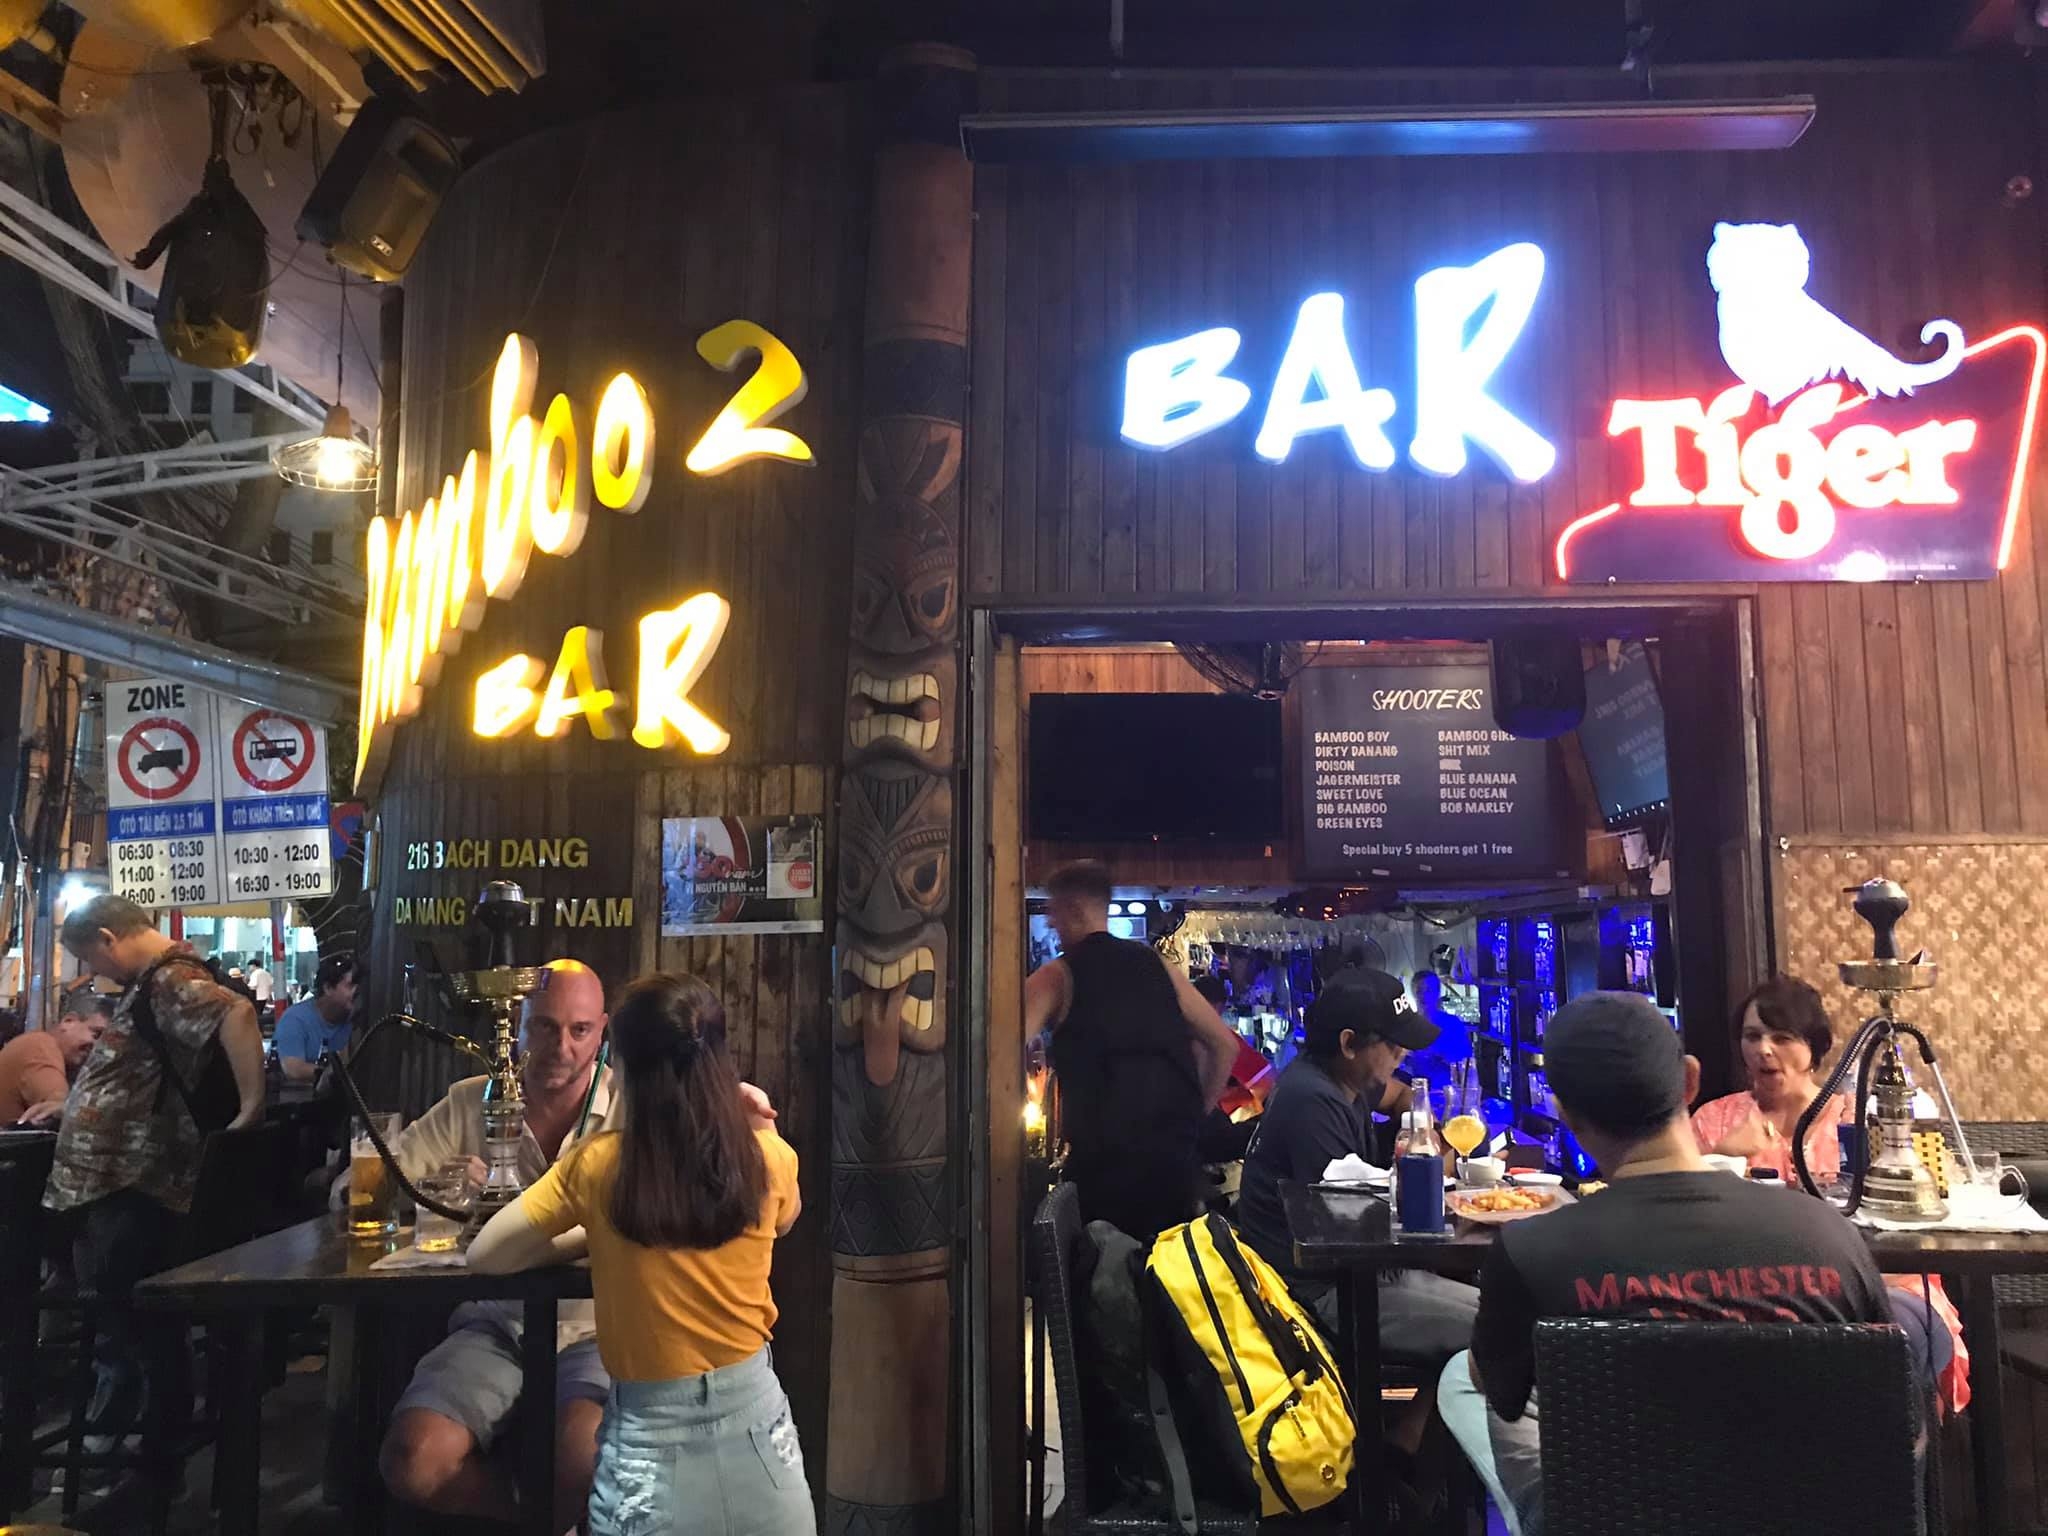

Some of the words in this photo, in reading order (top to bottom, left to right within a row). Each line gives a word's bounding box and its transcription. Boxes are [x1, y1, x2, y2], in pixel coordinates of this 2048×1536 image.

[1121, 242, 1555, 483] BAR
[687, 319, 813, 475] 2
[1608, 384, 1976, 561] Tiger
[474, 592, 730, 756] BAR
[127, 684, 185, 713] ZONE
[1372, 688, 1483, 711] SHOOTERS
[1314, 731, 1365, 743] BAMBOO
[1367, 731, 1390, 742] BOY
[1438, 730, 1488, 742] BAMBOO
[1315, 746, 1348, 757] DIRTY
[1351, 745, 1399, 757] DANANG
[1438, 744, 1464, 756] SHIT
[1466, 744, 1491, 756] MIX
[1315, 760, 1355, 772] POISON
[1316, 774, 1401, 786] JAGERMEISTER
[1439, 773, 1466, 785] BLUE
[1468, 773, 1518, 785] BANANA
[1316, 789, 1353, 801] SWEET
[1355, 788, 1384, 800] LOVE
[1440, 787, 1466, 799] BLUE
[1469, 787, 1507, 799] OCEAN
[1316, 803, 1335, 815] BIG
[1337, 802, 1388, 814] BAMBOO
[1440, 801, 1463, 814] BOB
[1465, 801, 1514, 813] MARLEY
[1317, 817, 1353, 829] GREEN
[1355, 817, 1383, 828] EYES
[118, 843, 154, 861] 06:30
[169, 840, 204, 859] 08:30
[233, 847, 269, 865] 10:30
[284, 844, 319, 862] 12:00
[407, 842, 429, 870] 216
[433, 839, 490, 869] BACH
[501, 837, 589, 868] DANG
[1342, 843, 1380, 857] Special
[1382, 843, 1402, 857] buy
[1405, 843, 1413, 855] 5
[1415, 843, 1460, 855] shooters
[1462, 844, 1478, 857] get
[1482, 843, 1487, 854] 1
[1491, 843, 1513, 854] free
[119, 866, 154, 883] 11:00
[170, 863, 205, 881] 12:00
[235, 875, 270, 893] 16:30
[285, 872, 321, 890] 19:00
[171, 885, 205, 902] 19:00
[415, 897, 465, 926] NANG
[555, 897, 634, 927] NAM
[1575, 1264, 1841, 1311] MANCHESTER
